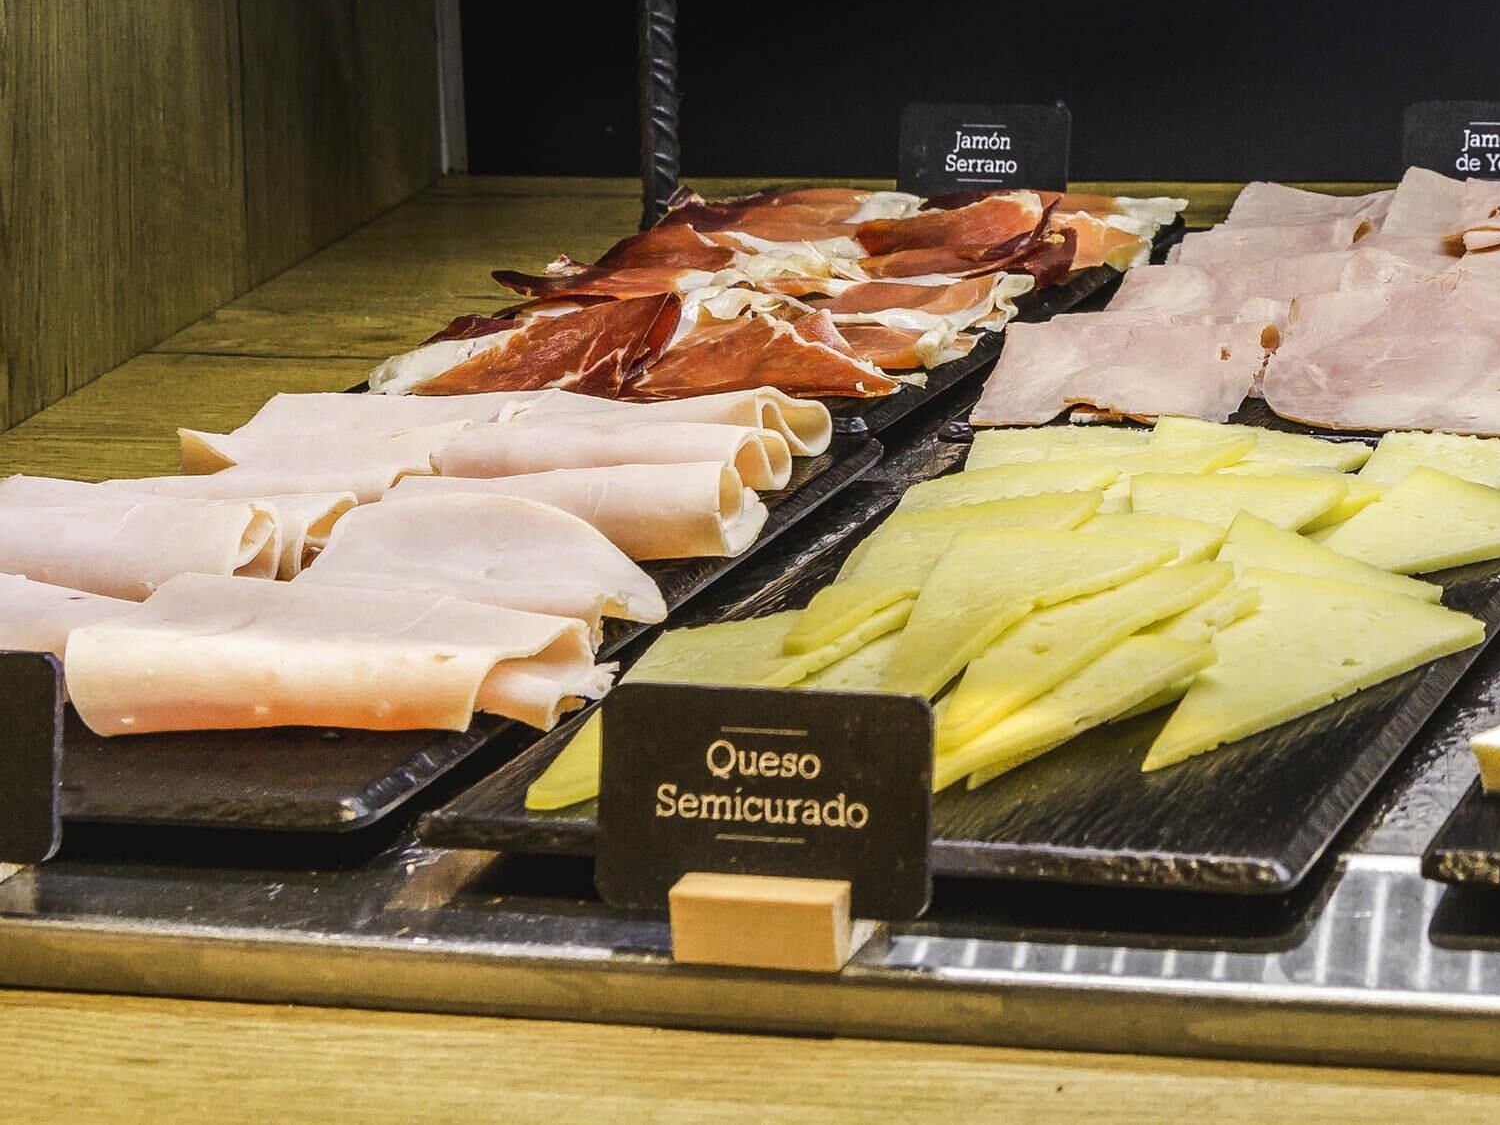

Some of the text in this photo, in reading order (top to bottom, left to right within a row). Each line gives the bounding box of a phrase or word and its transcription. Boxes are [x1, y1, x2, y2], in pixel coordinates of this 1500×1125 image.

[953, 131, 1011, 153] Jamón
[945, 154, 1018, 174] Serrano
[1455, 153, 1481, 172] de
[706, 739, 822, 780] Queso
